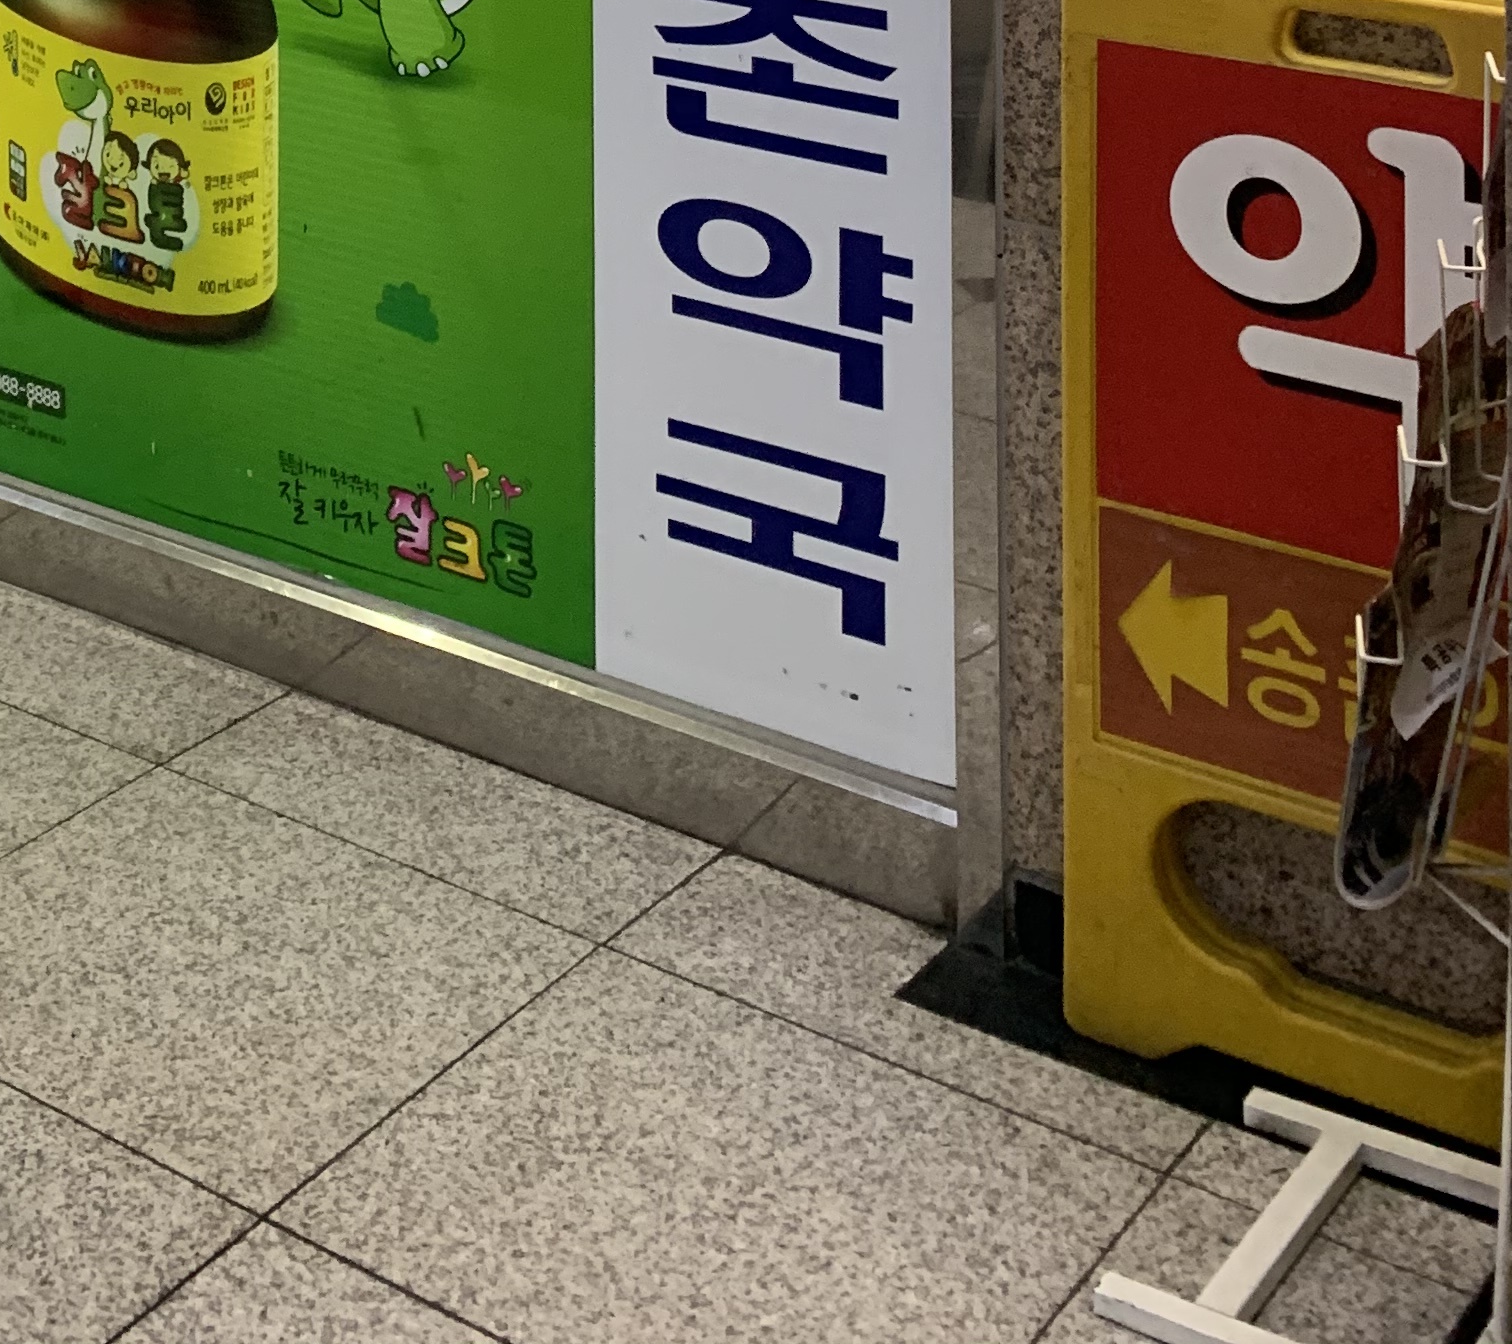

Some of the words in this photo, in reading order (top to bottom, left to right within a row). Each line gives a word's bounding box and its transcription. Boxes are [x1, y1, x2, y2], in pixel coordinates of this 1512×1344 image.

[123, 95, 192, 125] 우리아이
[54, 151, 188, 252] 잘크톤
[278, 479, 308, 526] 잘
[313, 497, 380, 536] 키우자
[386, 484, 538, 599] 잘크톤
